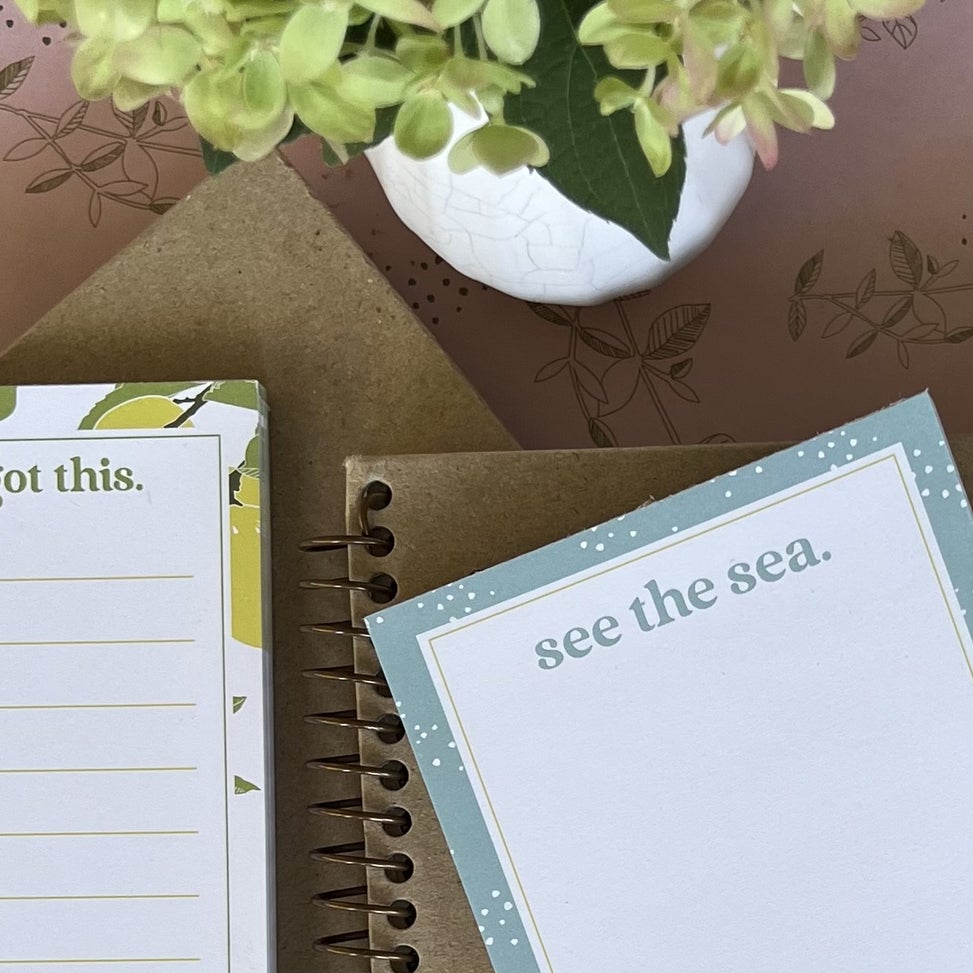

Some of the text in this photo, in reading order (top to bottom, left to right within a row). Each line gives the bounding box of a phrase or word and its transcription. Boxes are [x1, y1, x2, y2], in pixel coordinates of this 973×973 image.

[0, 456, 144, 509] ot this.
[534, 537, 832, 670] see the sea.
